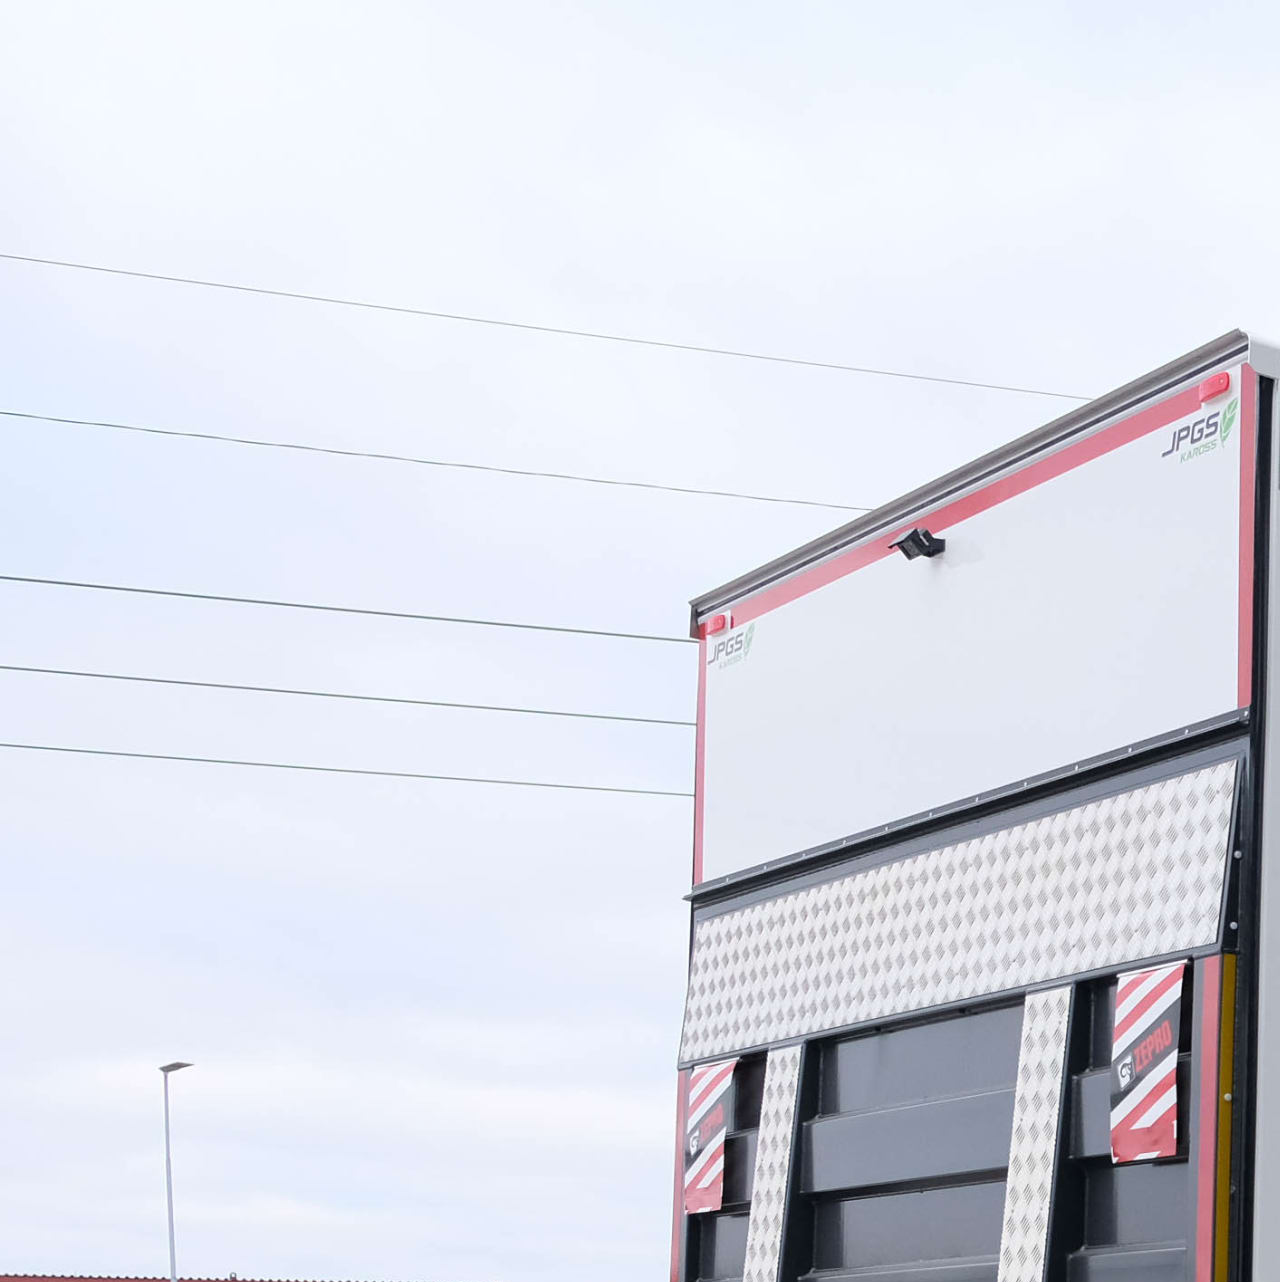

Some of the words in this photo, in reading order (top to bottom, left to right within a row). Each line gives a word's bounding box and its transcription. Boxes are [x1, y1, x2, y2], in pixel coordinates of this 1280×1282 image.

[1161, 411, 1220, 457] JPGS
[1180, 439, 1218, 463] KAROSS
[707, 632, 744, 665] JPGS
[1133, 1020, 1173, 1073] ZEPRO
